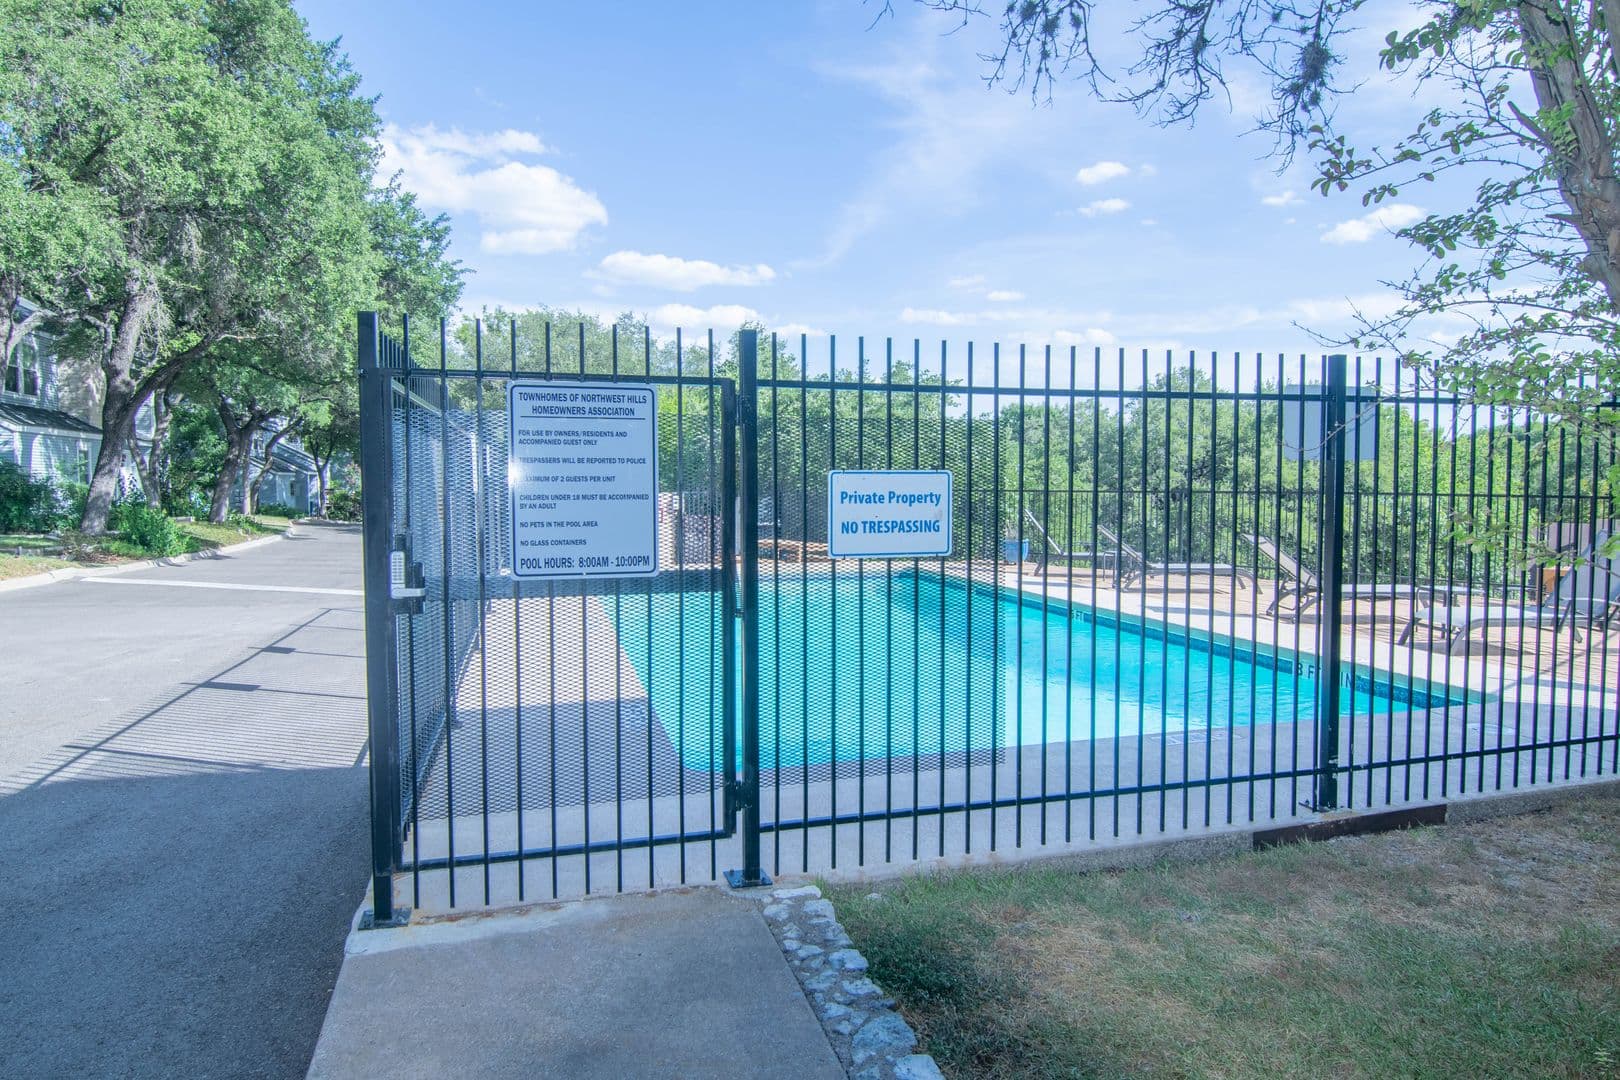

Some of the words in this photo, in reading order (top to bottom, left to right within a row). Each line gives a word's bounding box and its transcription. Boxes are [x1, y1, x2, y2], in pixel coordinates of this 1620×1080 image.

[519, 392, 567, 402] TOWNHOMES
[569, 393, 579, 402] OF
[581, 394, 626, 403] NORTHWEST
[627, 395, 647, 404] HILLS
[532, 406, 586, 415] HOMEOWNERS
[588, 407, 635, 416] ASSOCIATION
[840, 491, 884, 504] Private
[888, 491, 941, 507] Property
[841, 521, 858, 534] NO
[861, 520, 940, 533] TRESPASSING
[521, 558, 542, 569] POOL
[544, 557, 574, 568] HOURS:
[579, 556, 609, 568] 8:00AM
[616, 555, 650, 567] 10:00PM
